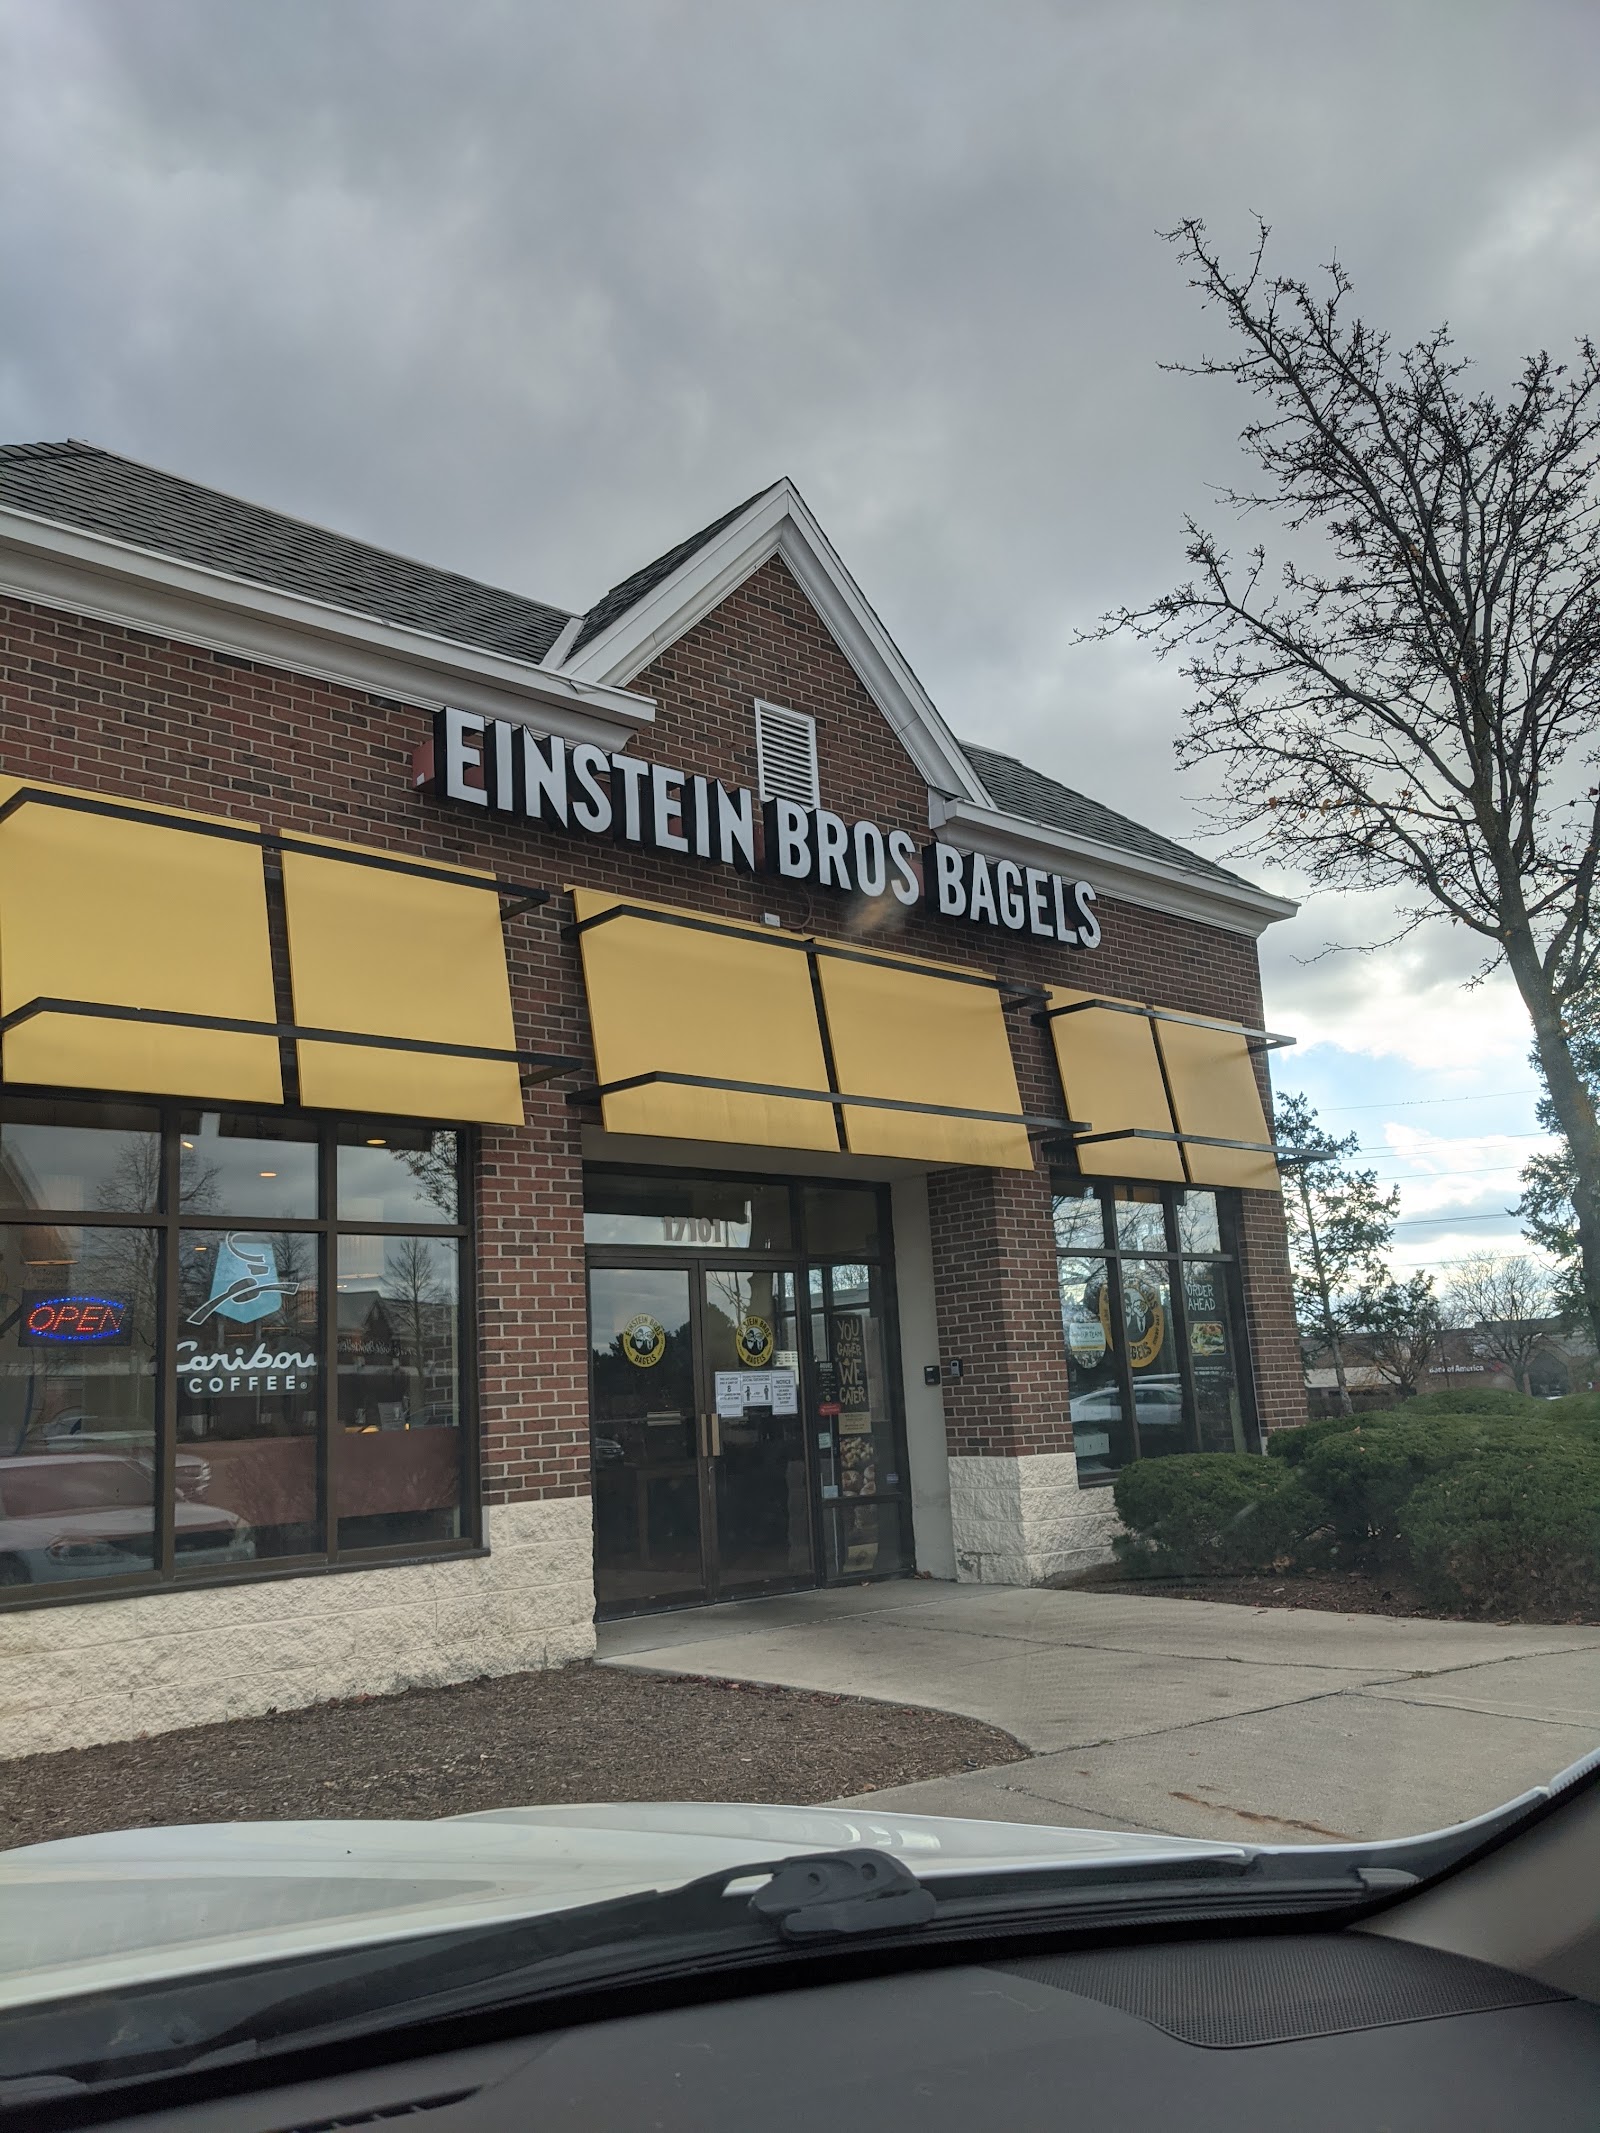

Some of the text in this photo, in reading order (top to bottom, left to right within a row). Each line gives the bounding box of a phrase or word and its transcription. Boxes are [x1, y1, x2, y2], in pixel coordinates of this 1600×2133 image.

[444, 706, 1102, 949] EINSTEIN BROS BAGELS
[664, 1216, 721, 1243] 17101
[1187, 1284, 1214, 1297] ORDER
[1188, 1298, 1216, 1311] AHEAD
[27, 1306, 127, 1331] OPEN
[625, 1315, 664, 1336] EINSTEIN BROS
[759, 1320, 772, 1337] BROS
[837, 1319, 860, 1341] YOU
[176, 1340, 317, 1373] Caribou
[837, 1343, 863, 1356] GATHER
[1130, 1342, 1152, 1360] GELS
[635, 1354, 657, 1365] BAGELS
[746, 1354, 767, 1365] BAGELS
[839, 1358, 864, 1386] WE
[189, 1375, 296, 1394] COFFEE
[840, 1387, 867, 1405] CATER
